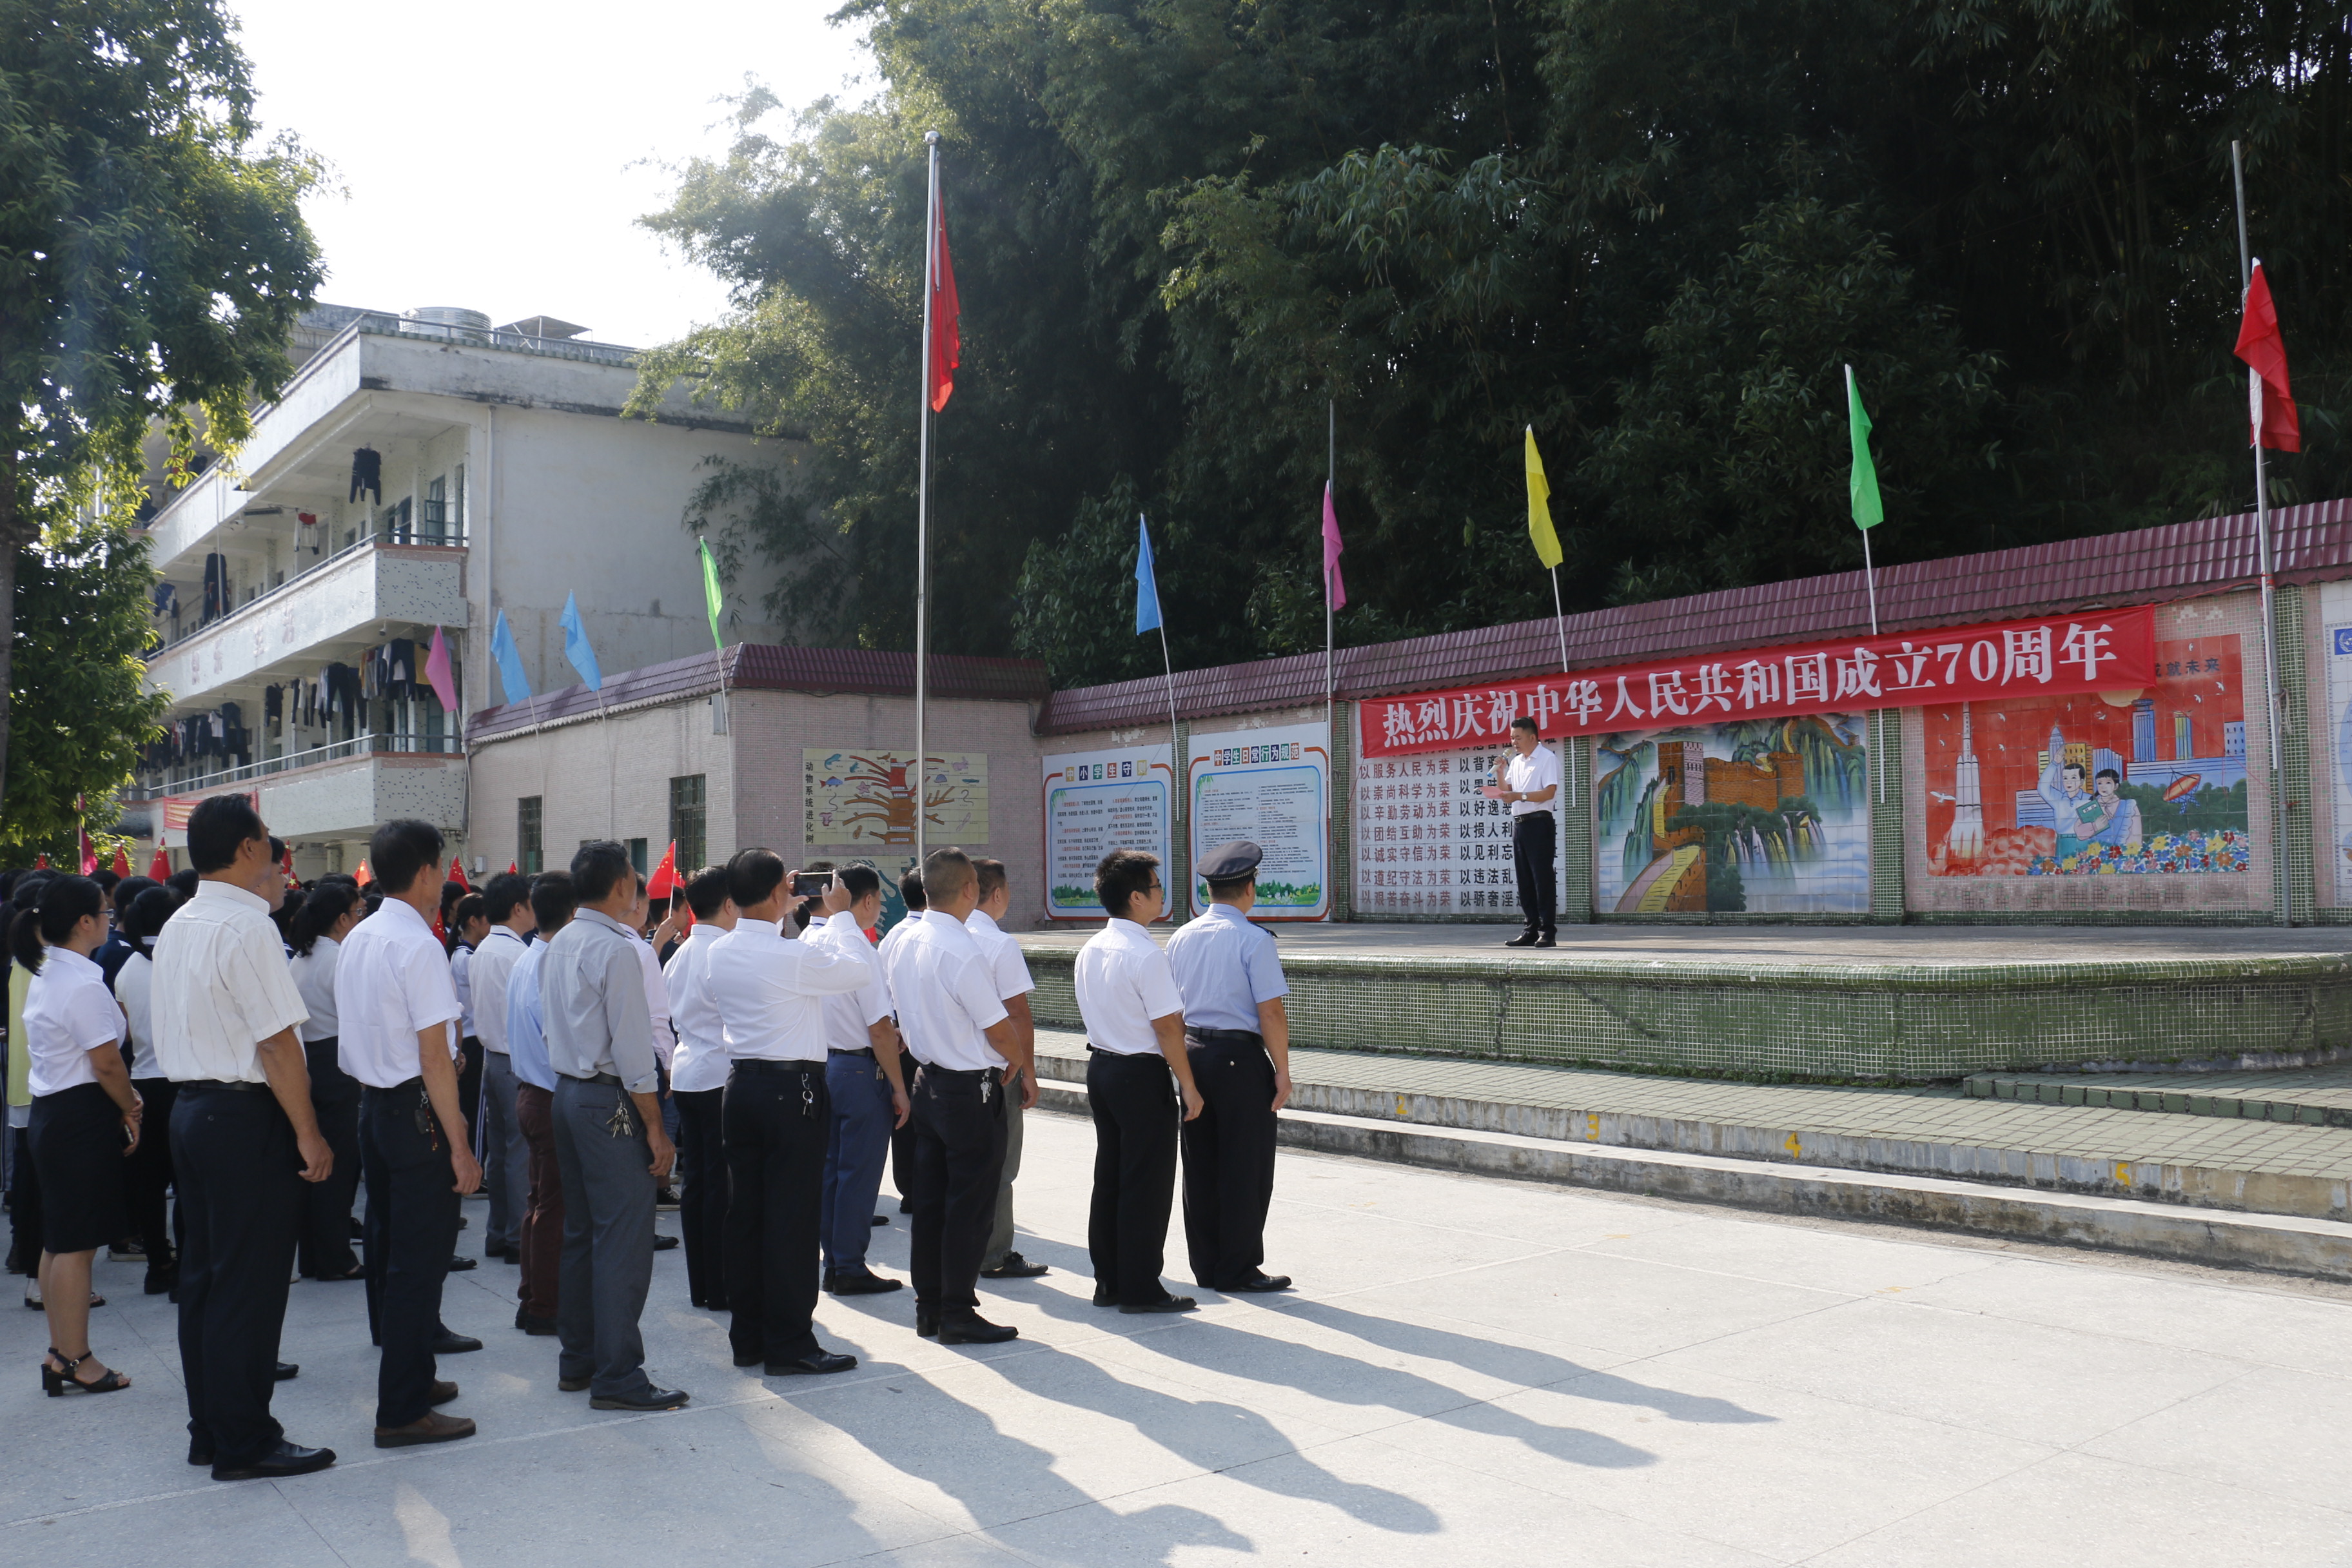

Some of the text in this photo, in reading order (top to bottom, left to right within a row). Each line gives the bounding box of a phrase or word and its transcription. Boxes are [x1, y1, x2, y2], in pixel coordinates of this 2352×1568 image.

[1383, 622, 2117, 748] 热烈庆祝中华人民共和国成立70周年
[1214, 743, 1299, 765] 中学生日常行为规范
[1066, 761, 1146, 781] 中小学生守则
[1360, 759, 1449, 779] 以服务人民为荣
[1361, 781, 1449, 801] 以崇尚科学为荣
[805, 761, 814, 844] 动物系统进化树
[1361, 801, 1450, 821] 以辛勤劳动为荣
[1361, 823, 1450, 841] 以团结互助为荣
[1361, 845, 1451, 863] 以诚实守信为荣
[1361, 868, 1451, 886] 以遵纪守法为荣
[1361, 890, 1451, 908] 以艰苦奋斗为荣
